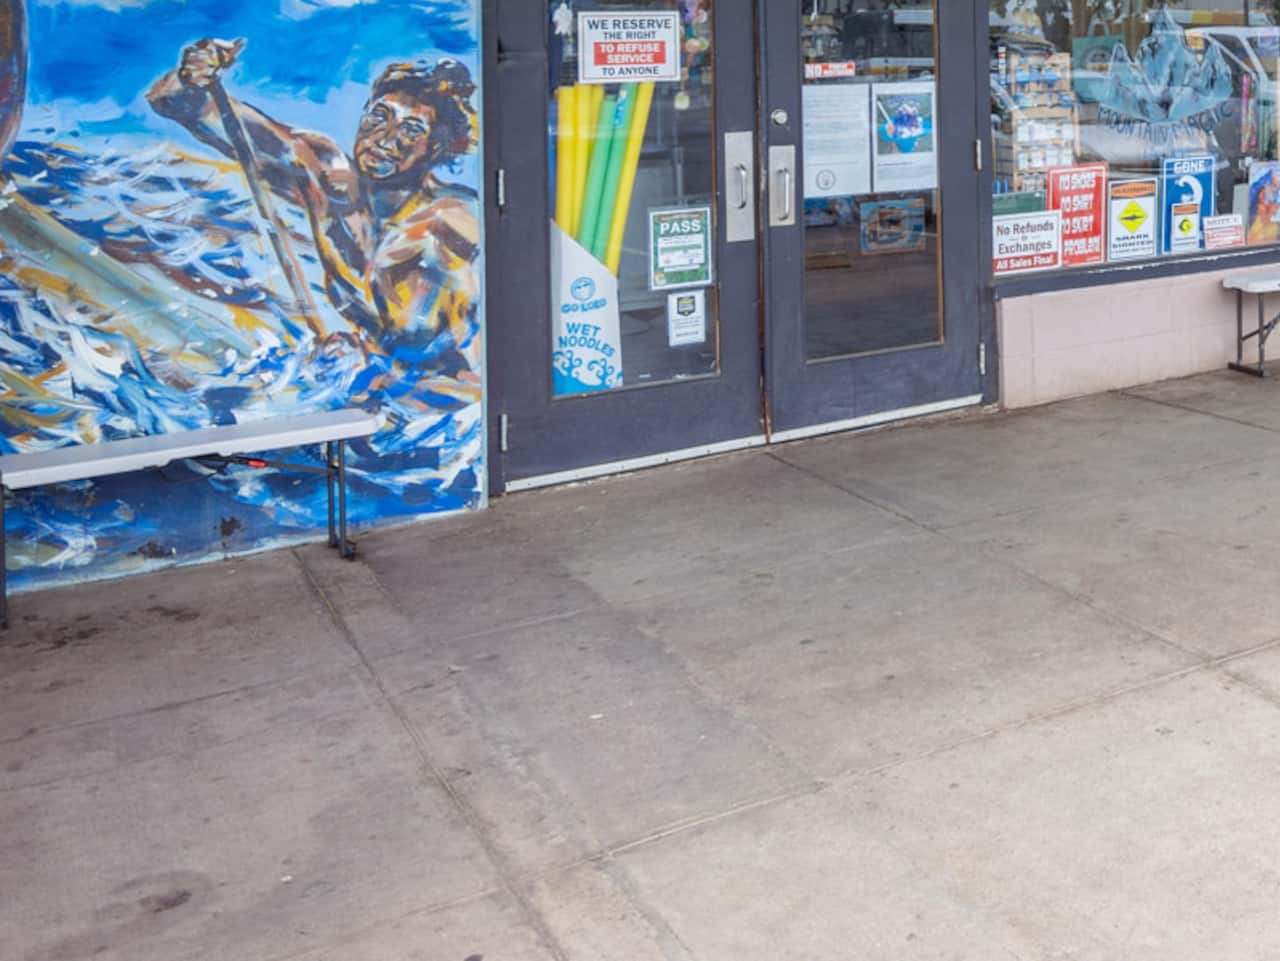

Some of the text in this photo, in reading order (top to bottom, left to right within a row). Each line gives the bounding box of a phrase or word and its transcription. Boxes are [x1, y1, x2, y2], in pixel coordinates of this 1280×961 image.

[588, 18, 672, 29] WE RESERVE
[603, 31, 656, 40] THE RIGHT
[601, 43, 660, 53] TO REFUSE
[607, 53, 655, 64] SERVICE
[602, 66, 660, 75] TO ANYONE
[1174, 159, 1206, 173] GONE
[660, 219, 702, 235] PASS
[996, 222, 1054, 236] No Refunds
[998, 241, 1053, 255] Exchanges
[996, 254, 1054, 269] All Sales Final
[566, 322, 601, 336] WET
[558, 336, 615, 357] NOODLES
